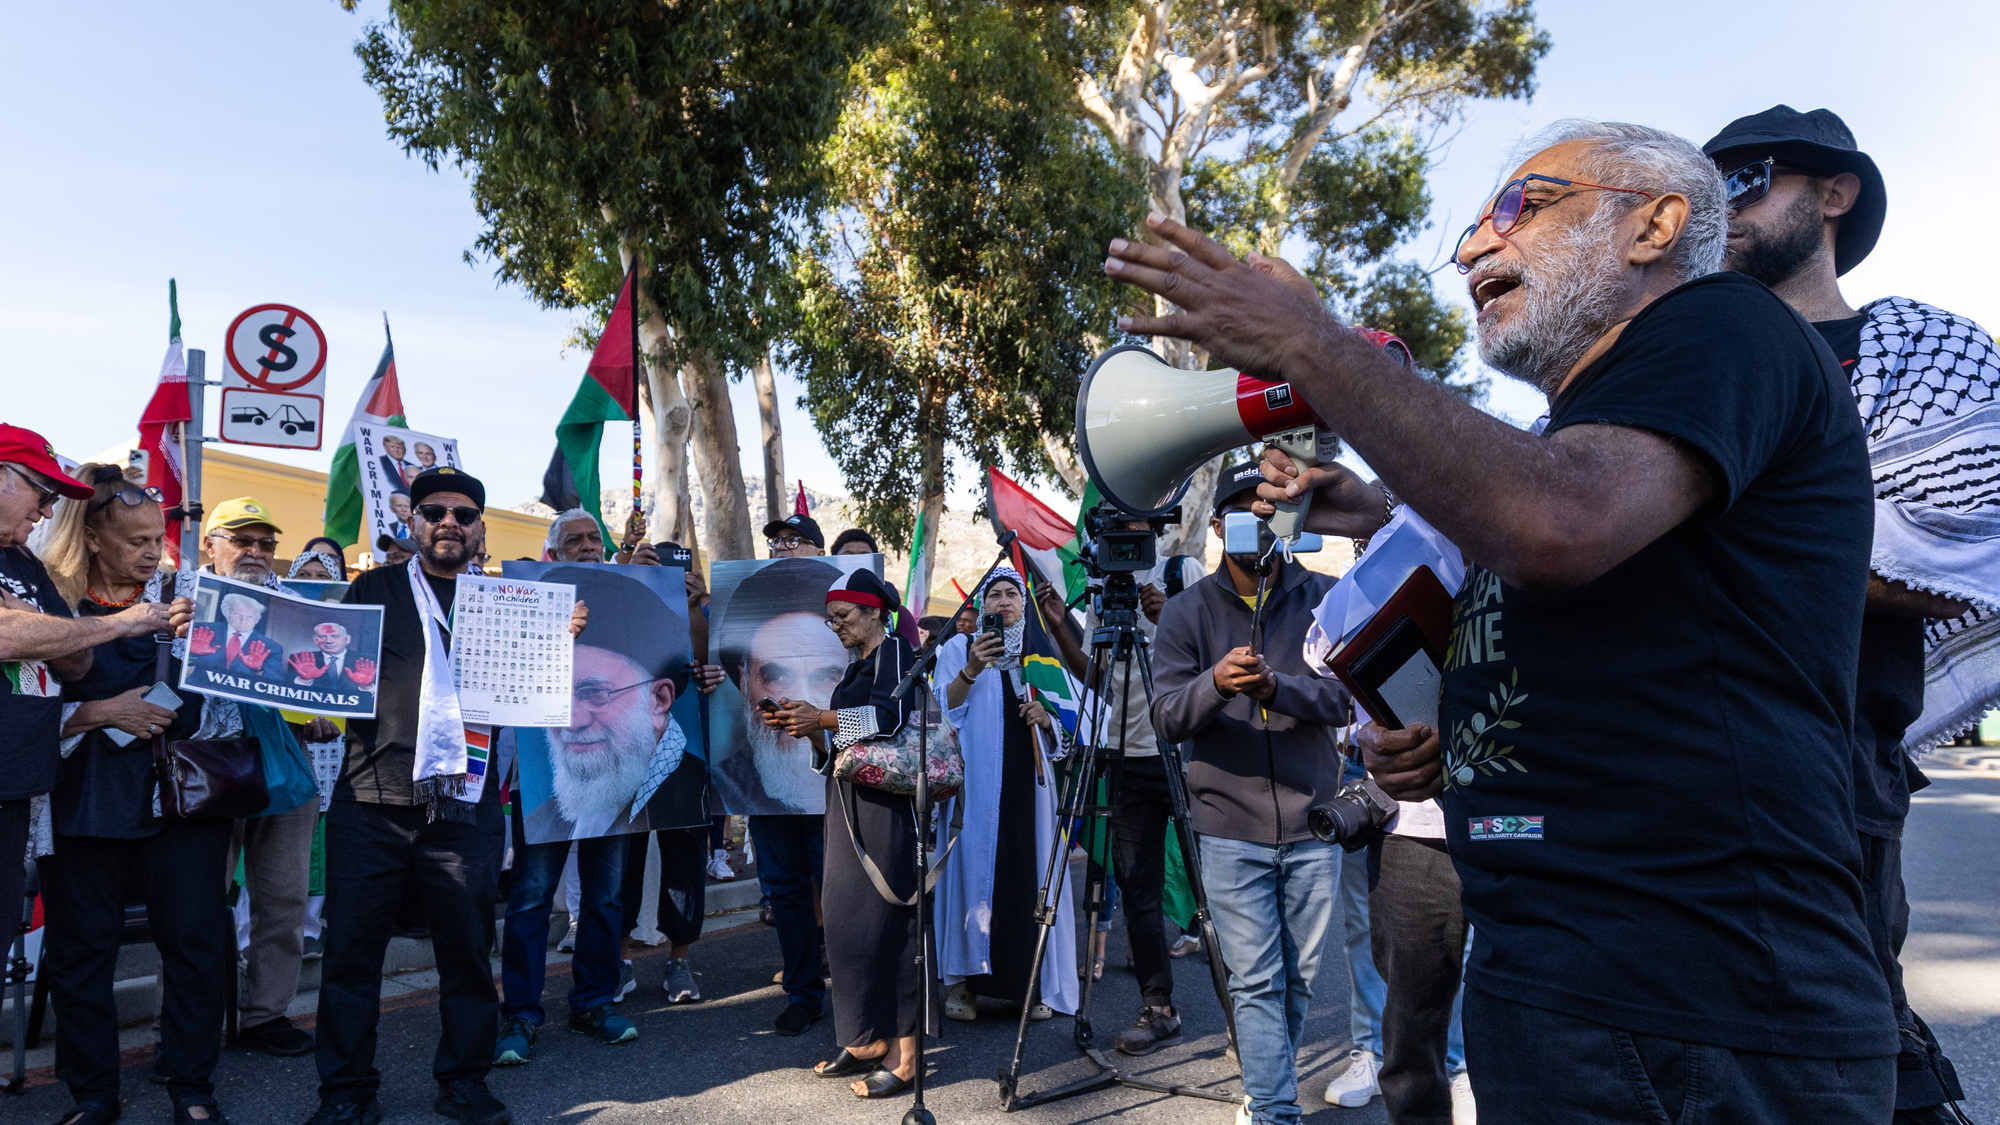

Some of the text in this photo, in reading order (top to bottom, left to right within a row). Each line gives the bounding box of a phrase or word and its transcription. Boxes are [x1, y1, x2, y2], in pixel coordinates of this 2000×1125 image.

[256, 323, 298, 372] S
[360, 427, 373, 456] WAR
[1234, 468, 1263, 480] mdd
[493, 594, 540, 604] on children
[498, 585, 536, 596] NO War
[205, 670, 360, 706] WAR CRIMINALS
[1482, 817, 1517, 834] PSC
